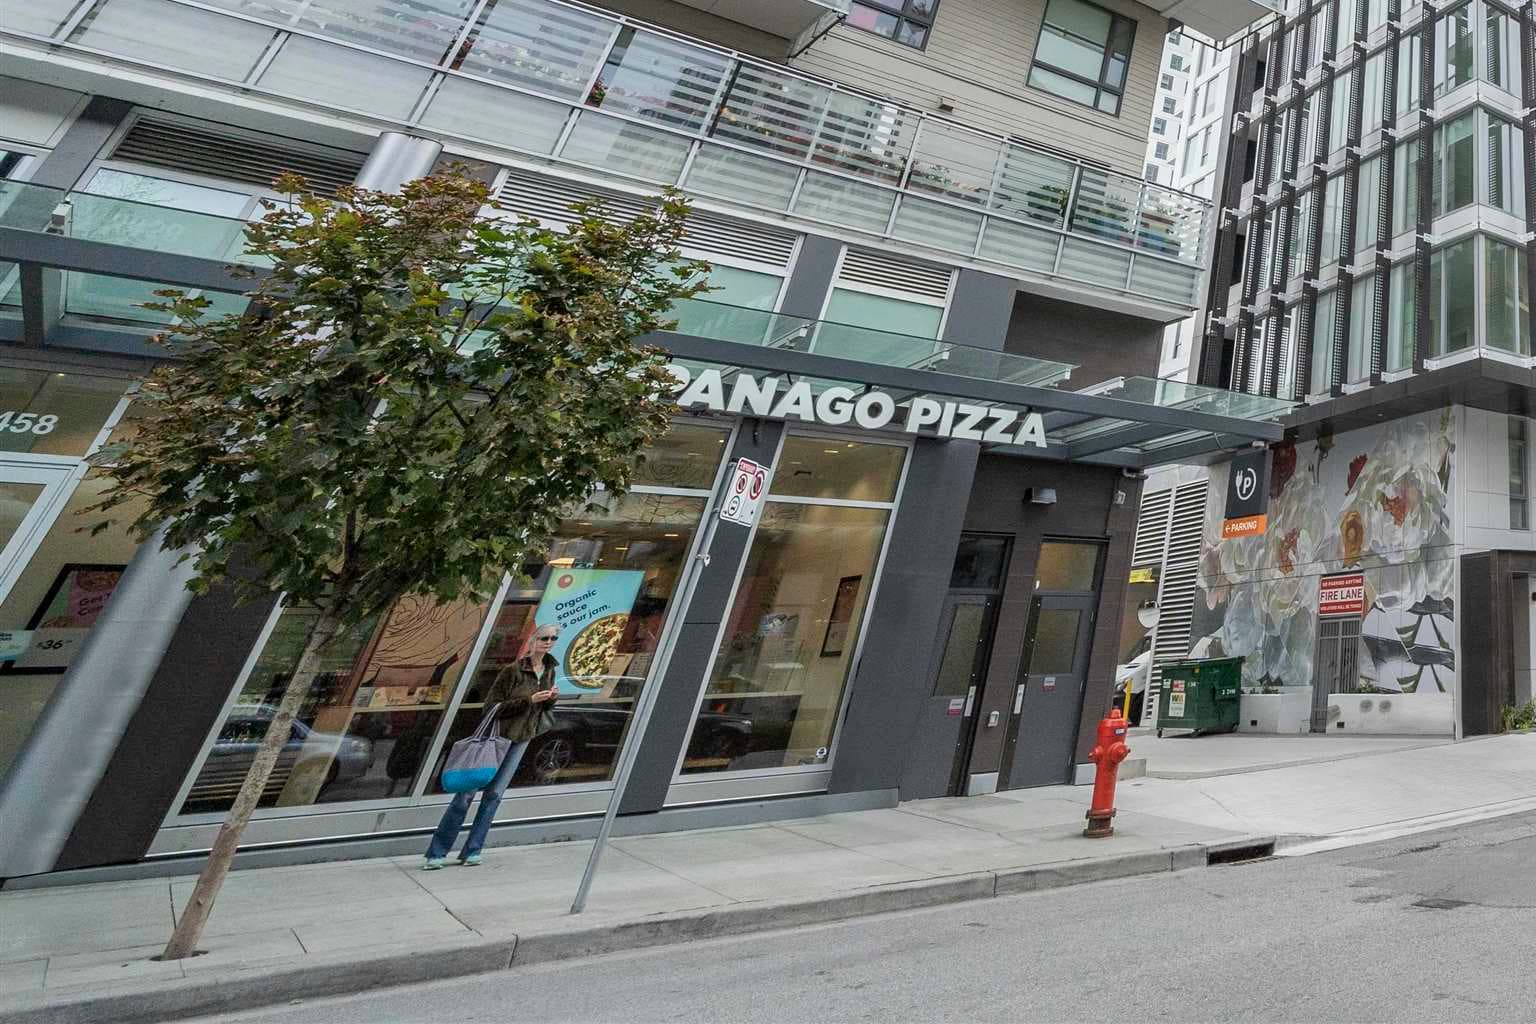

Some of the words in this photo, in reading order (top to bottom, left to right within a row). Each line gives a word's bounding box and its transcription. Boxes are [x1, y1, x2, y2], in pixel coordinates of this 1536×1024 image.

[906, 397, 1048, 449] PIZZA
[1230, 519, 1257, 533] PARKING
[555, 589, 598, 611] Organic
[1320, 590, 1339, 601] FIRE
[1340, 588, 1363, 600] LANE
[557, 603, 588, 621] sauce
[569, 613, 587, 626] our
[588, 603, 612, 620] jam.
